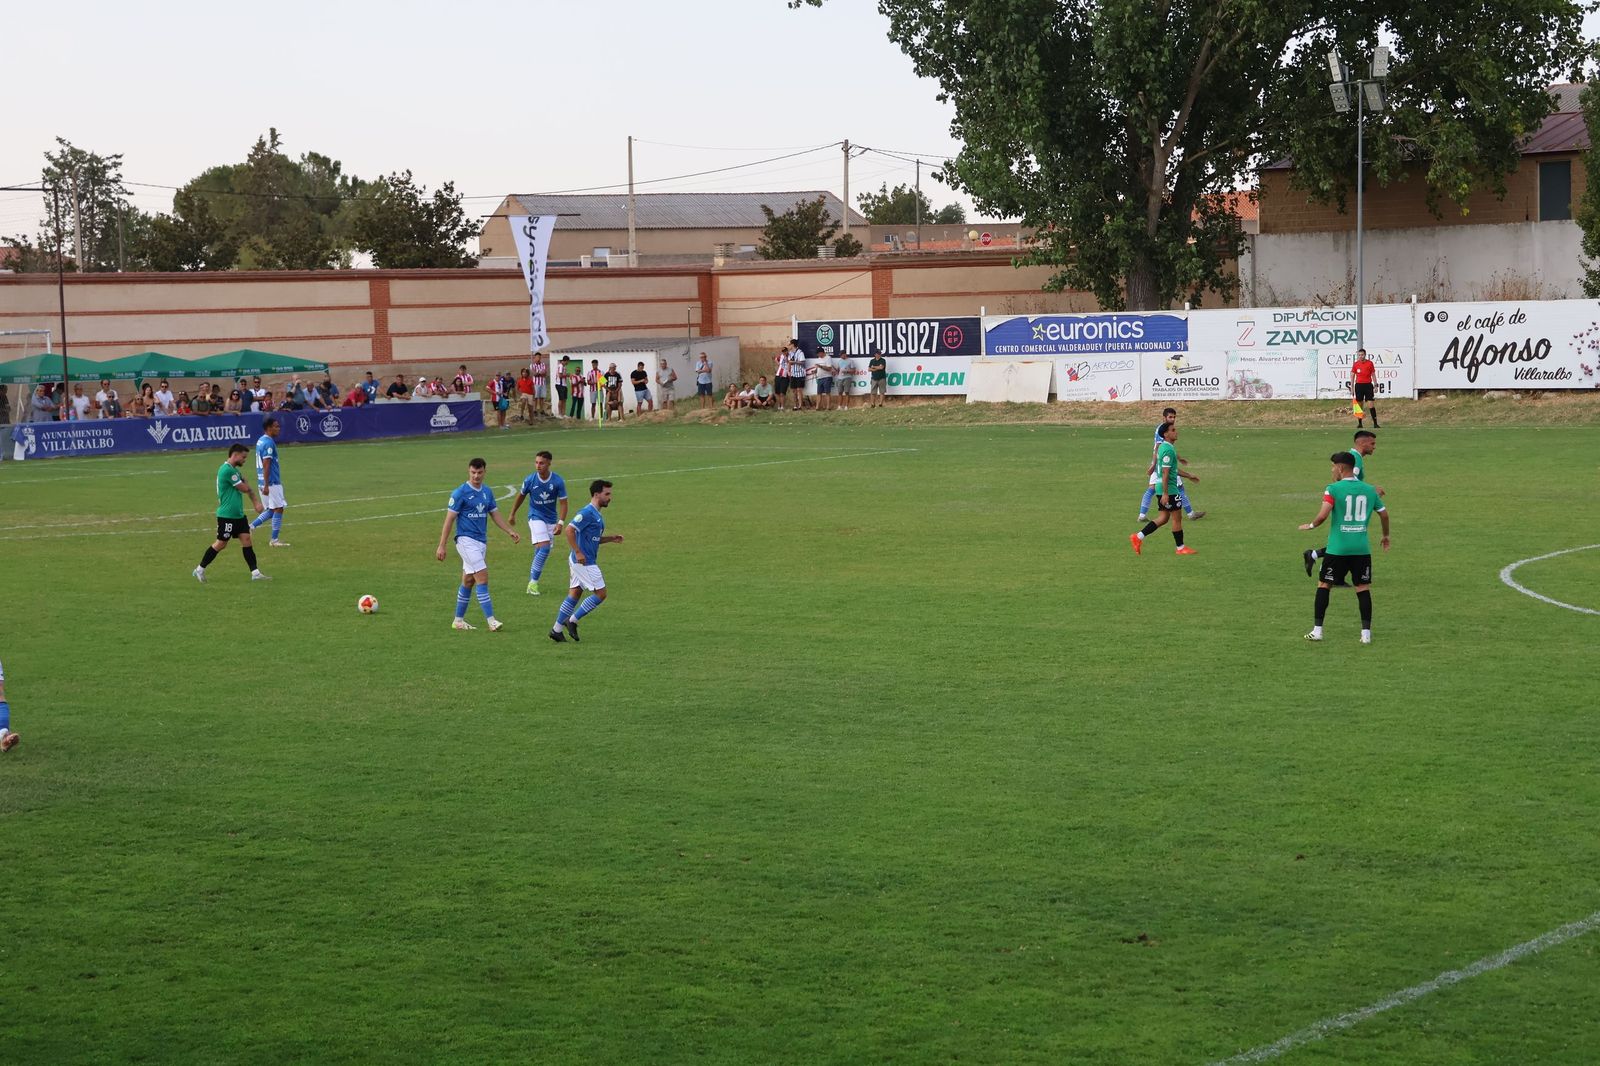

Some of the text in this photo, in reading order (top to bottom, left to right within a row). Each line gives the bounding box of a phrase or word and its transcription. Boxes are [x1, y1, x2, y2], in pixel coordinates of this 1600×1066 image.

[1046, 316, 1143, 340] euronics
[1457, 307, 1527, 335] el café de
[839, 322, 939, 355] IMPULSO27
[995, 345, 1019, 353] CENTRO
[1021, 344, 1056, 352] COMERCIAL
[1058, 343, 1102, 352] VALDERADUEY
[1105, 342, 1132, 352] (PUERTA
[1438, 333, 1552, 383] Alfonso
[1152, 377, 1220, 387] A. CARRILLO
[1514, 367, 1572, 381] Villaralbo
[41, 428, 113, 440] AYUNTAMIENTO DE
[172, 425, 250, 443] CAJA RURAL
[42, 438, 115, 451] VILLARALBO
[1344, 495, 1367, 521] 10
[224, 523, 233, 532] 18
